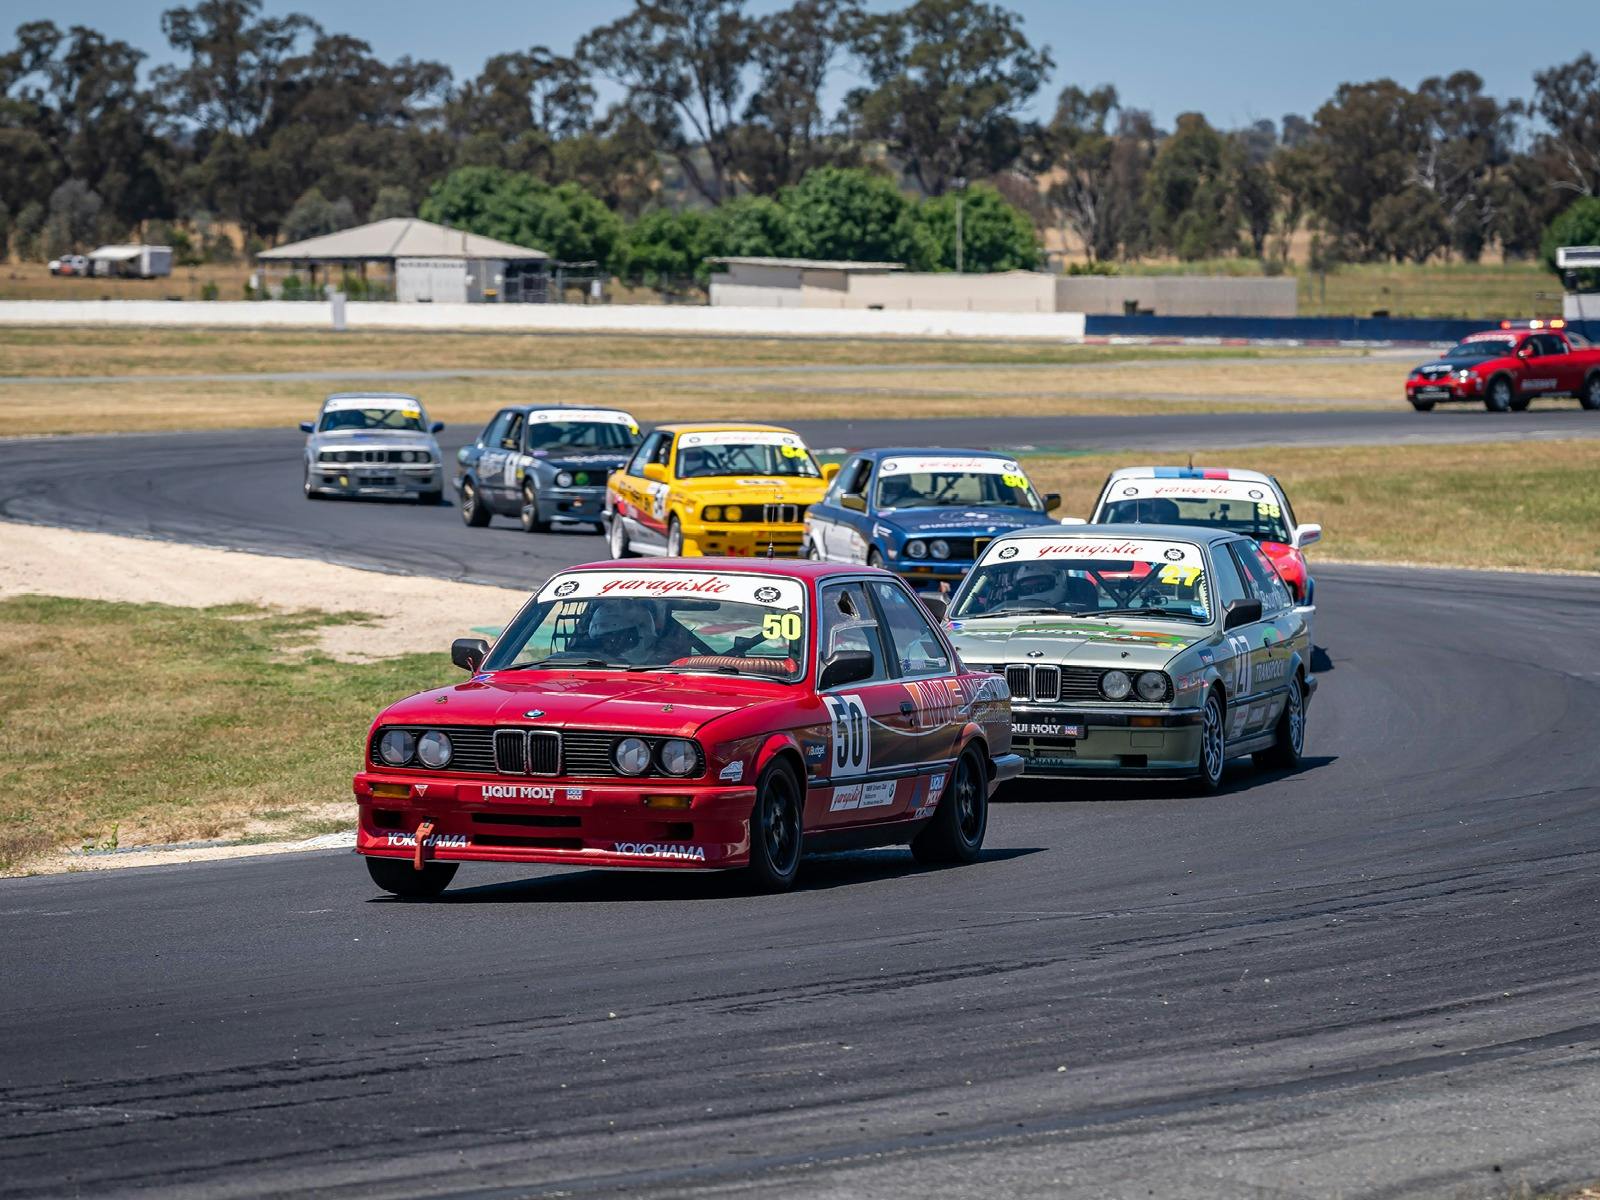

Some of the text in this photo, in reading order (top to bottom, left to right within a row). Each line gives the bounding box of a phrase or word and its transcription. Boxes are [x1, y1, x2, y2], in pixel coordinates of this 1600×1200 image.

[1037, 542, 1143, 558] garagistic
[1161, 565, 1201, 587] 27
[597, 577, 730, 596] garagistic
[763, 613, 801, 640] 50
[831, 702, 864, 768] 50
[1011, 723, 1061, 734] QUI MOLY
[482, 785, 555, 799] LIQUI MOLY
[388, 833, 466, 848] YOKHAMA
[615, 842, 705, 861] YOKOHAMA
